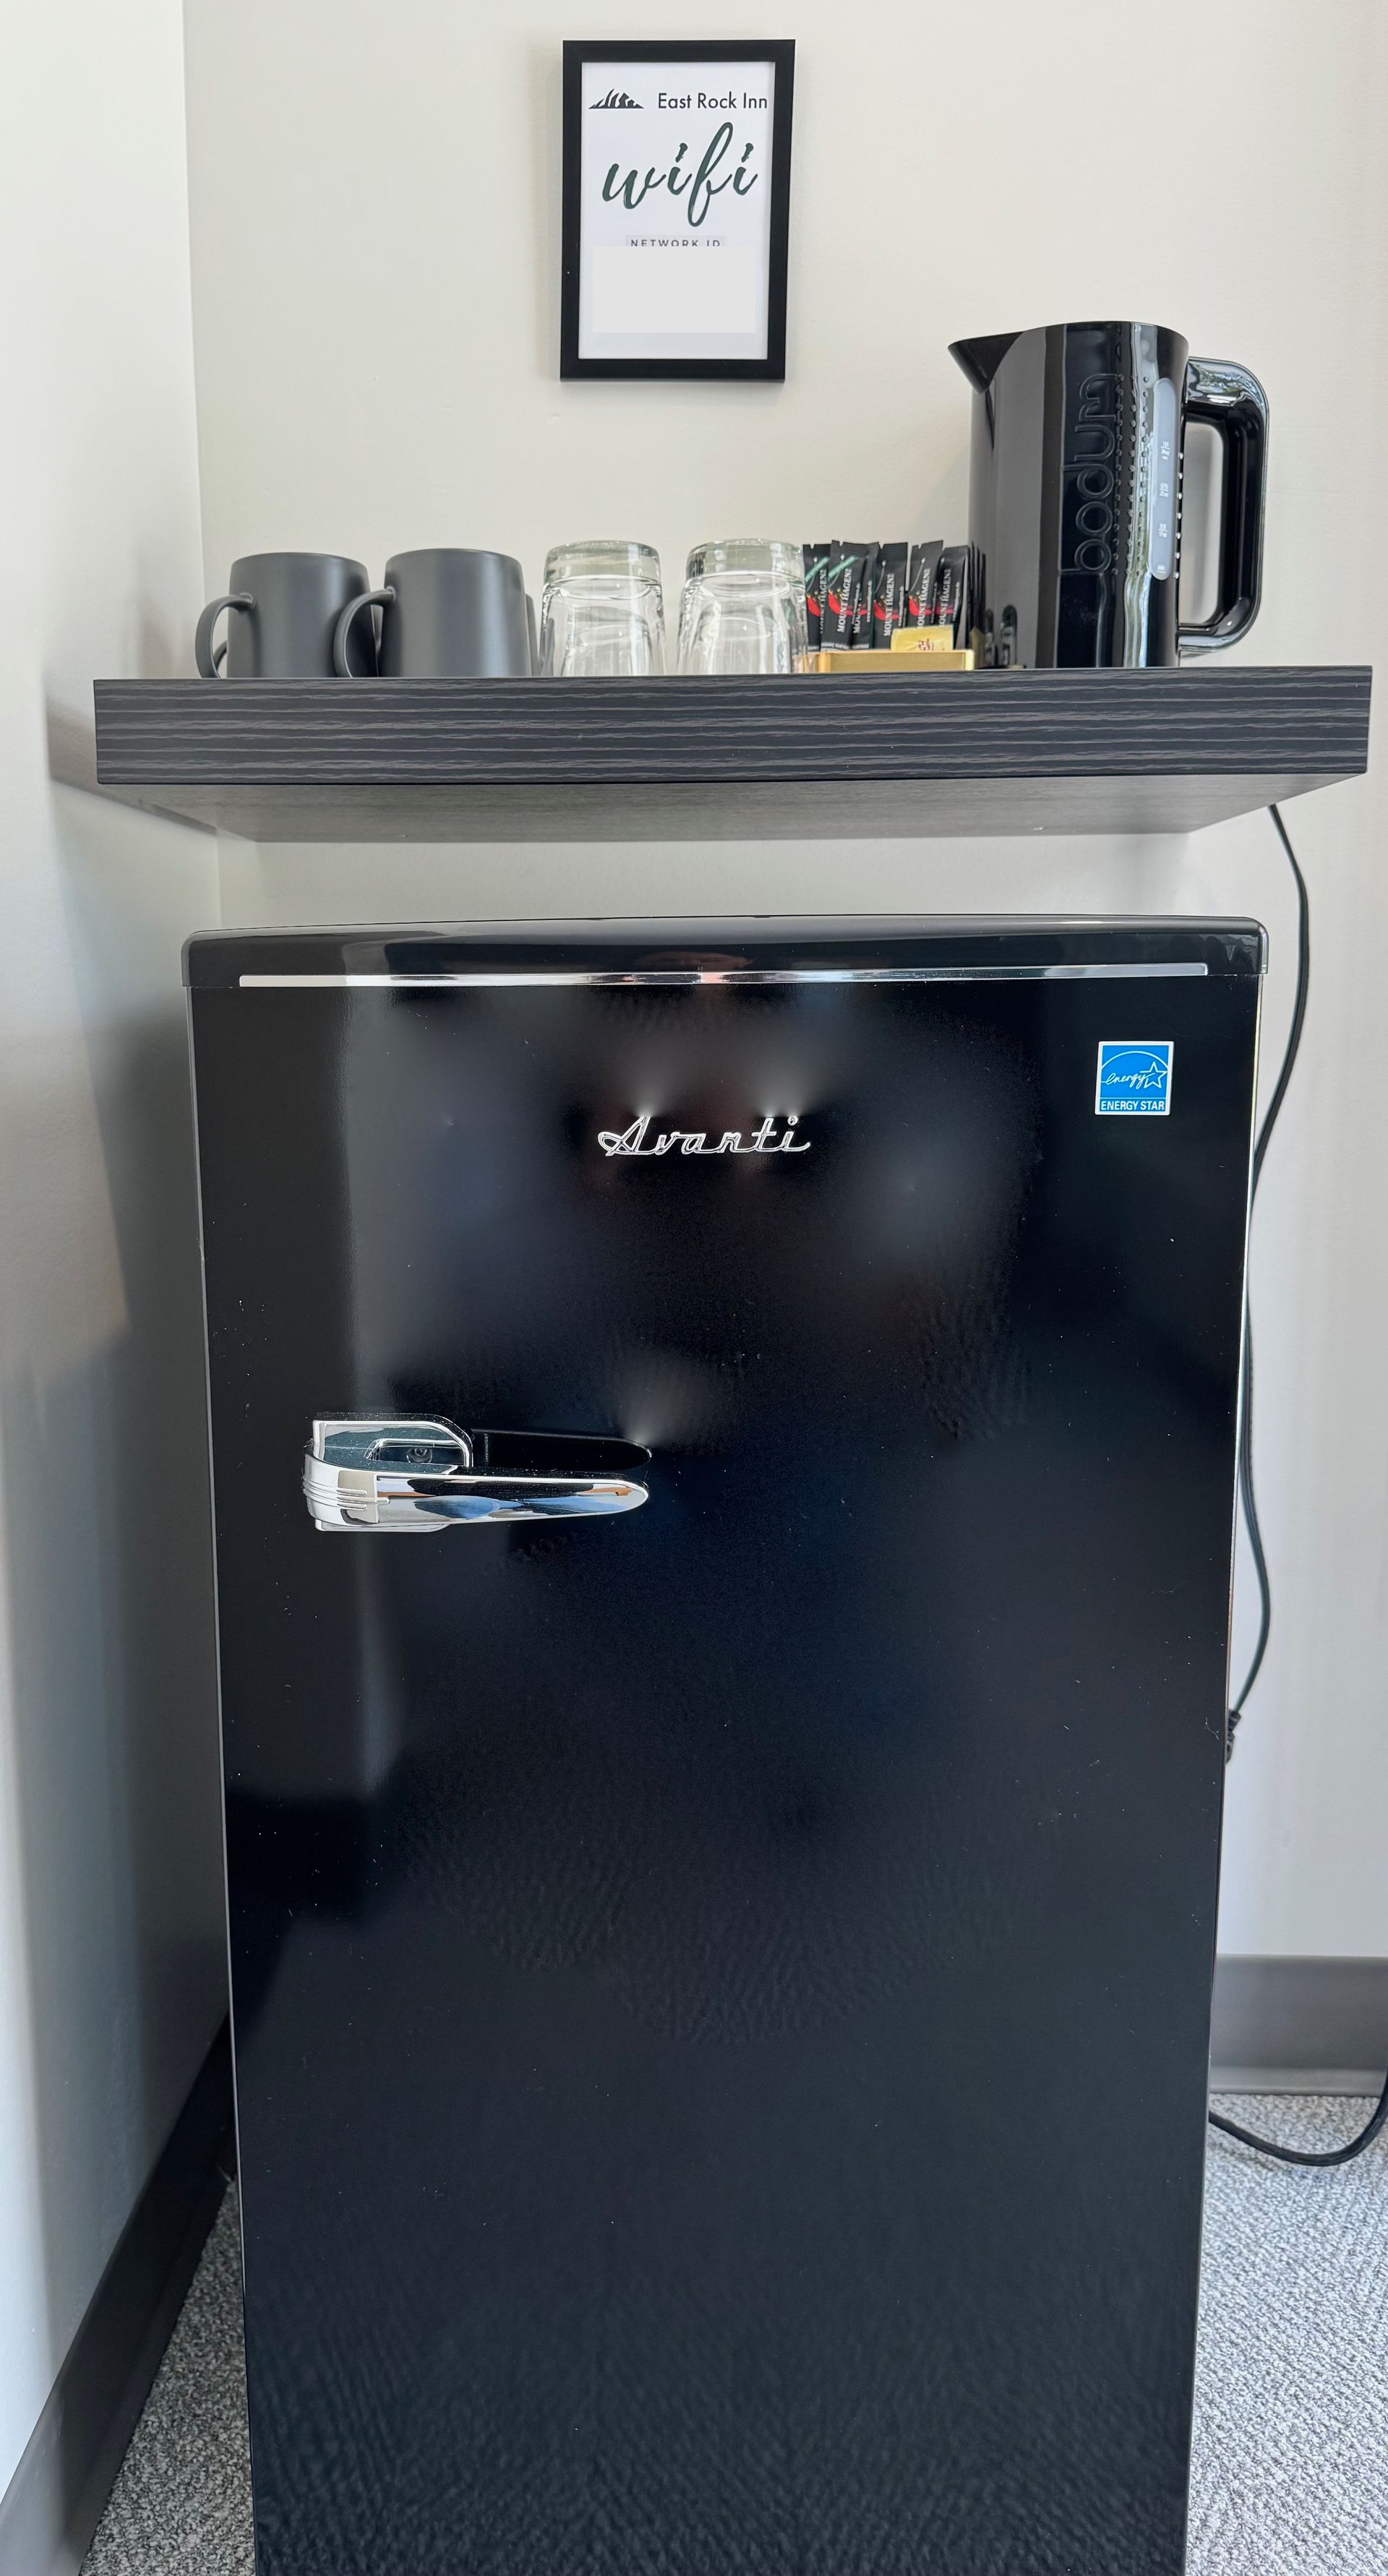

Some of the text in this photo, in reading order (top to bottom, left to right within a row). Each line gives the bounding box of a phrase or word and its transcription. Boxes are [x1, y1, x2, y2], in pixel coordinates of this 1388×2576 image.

[659, 91, 768, 108] East Rock Inn
[602, 121, 758, 227] wifi
[1062, 374, 1118, 573] bodum
[837, 601, 849, 633] MOUNT
[883, 607, 893, 636] MOUNT
[917, 602, 927, 627] OUNT
[938, 602, 948, 626] OUNT
[1102, 1073, 1154, 1089] energy
[1101, 1101, 1165, 1110] ENERGY STAR
[598, 1115, 810, 1156] Avanti
